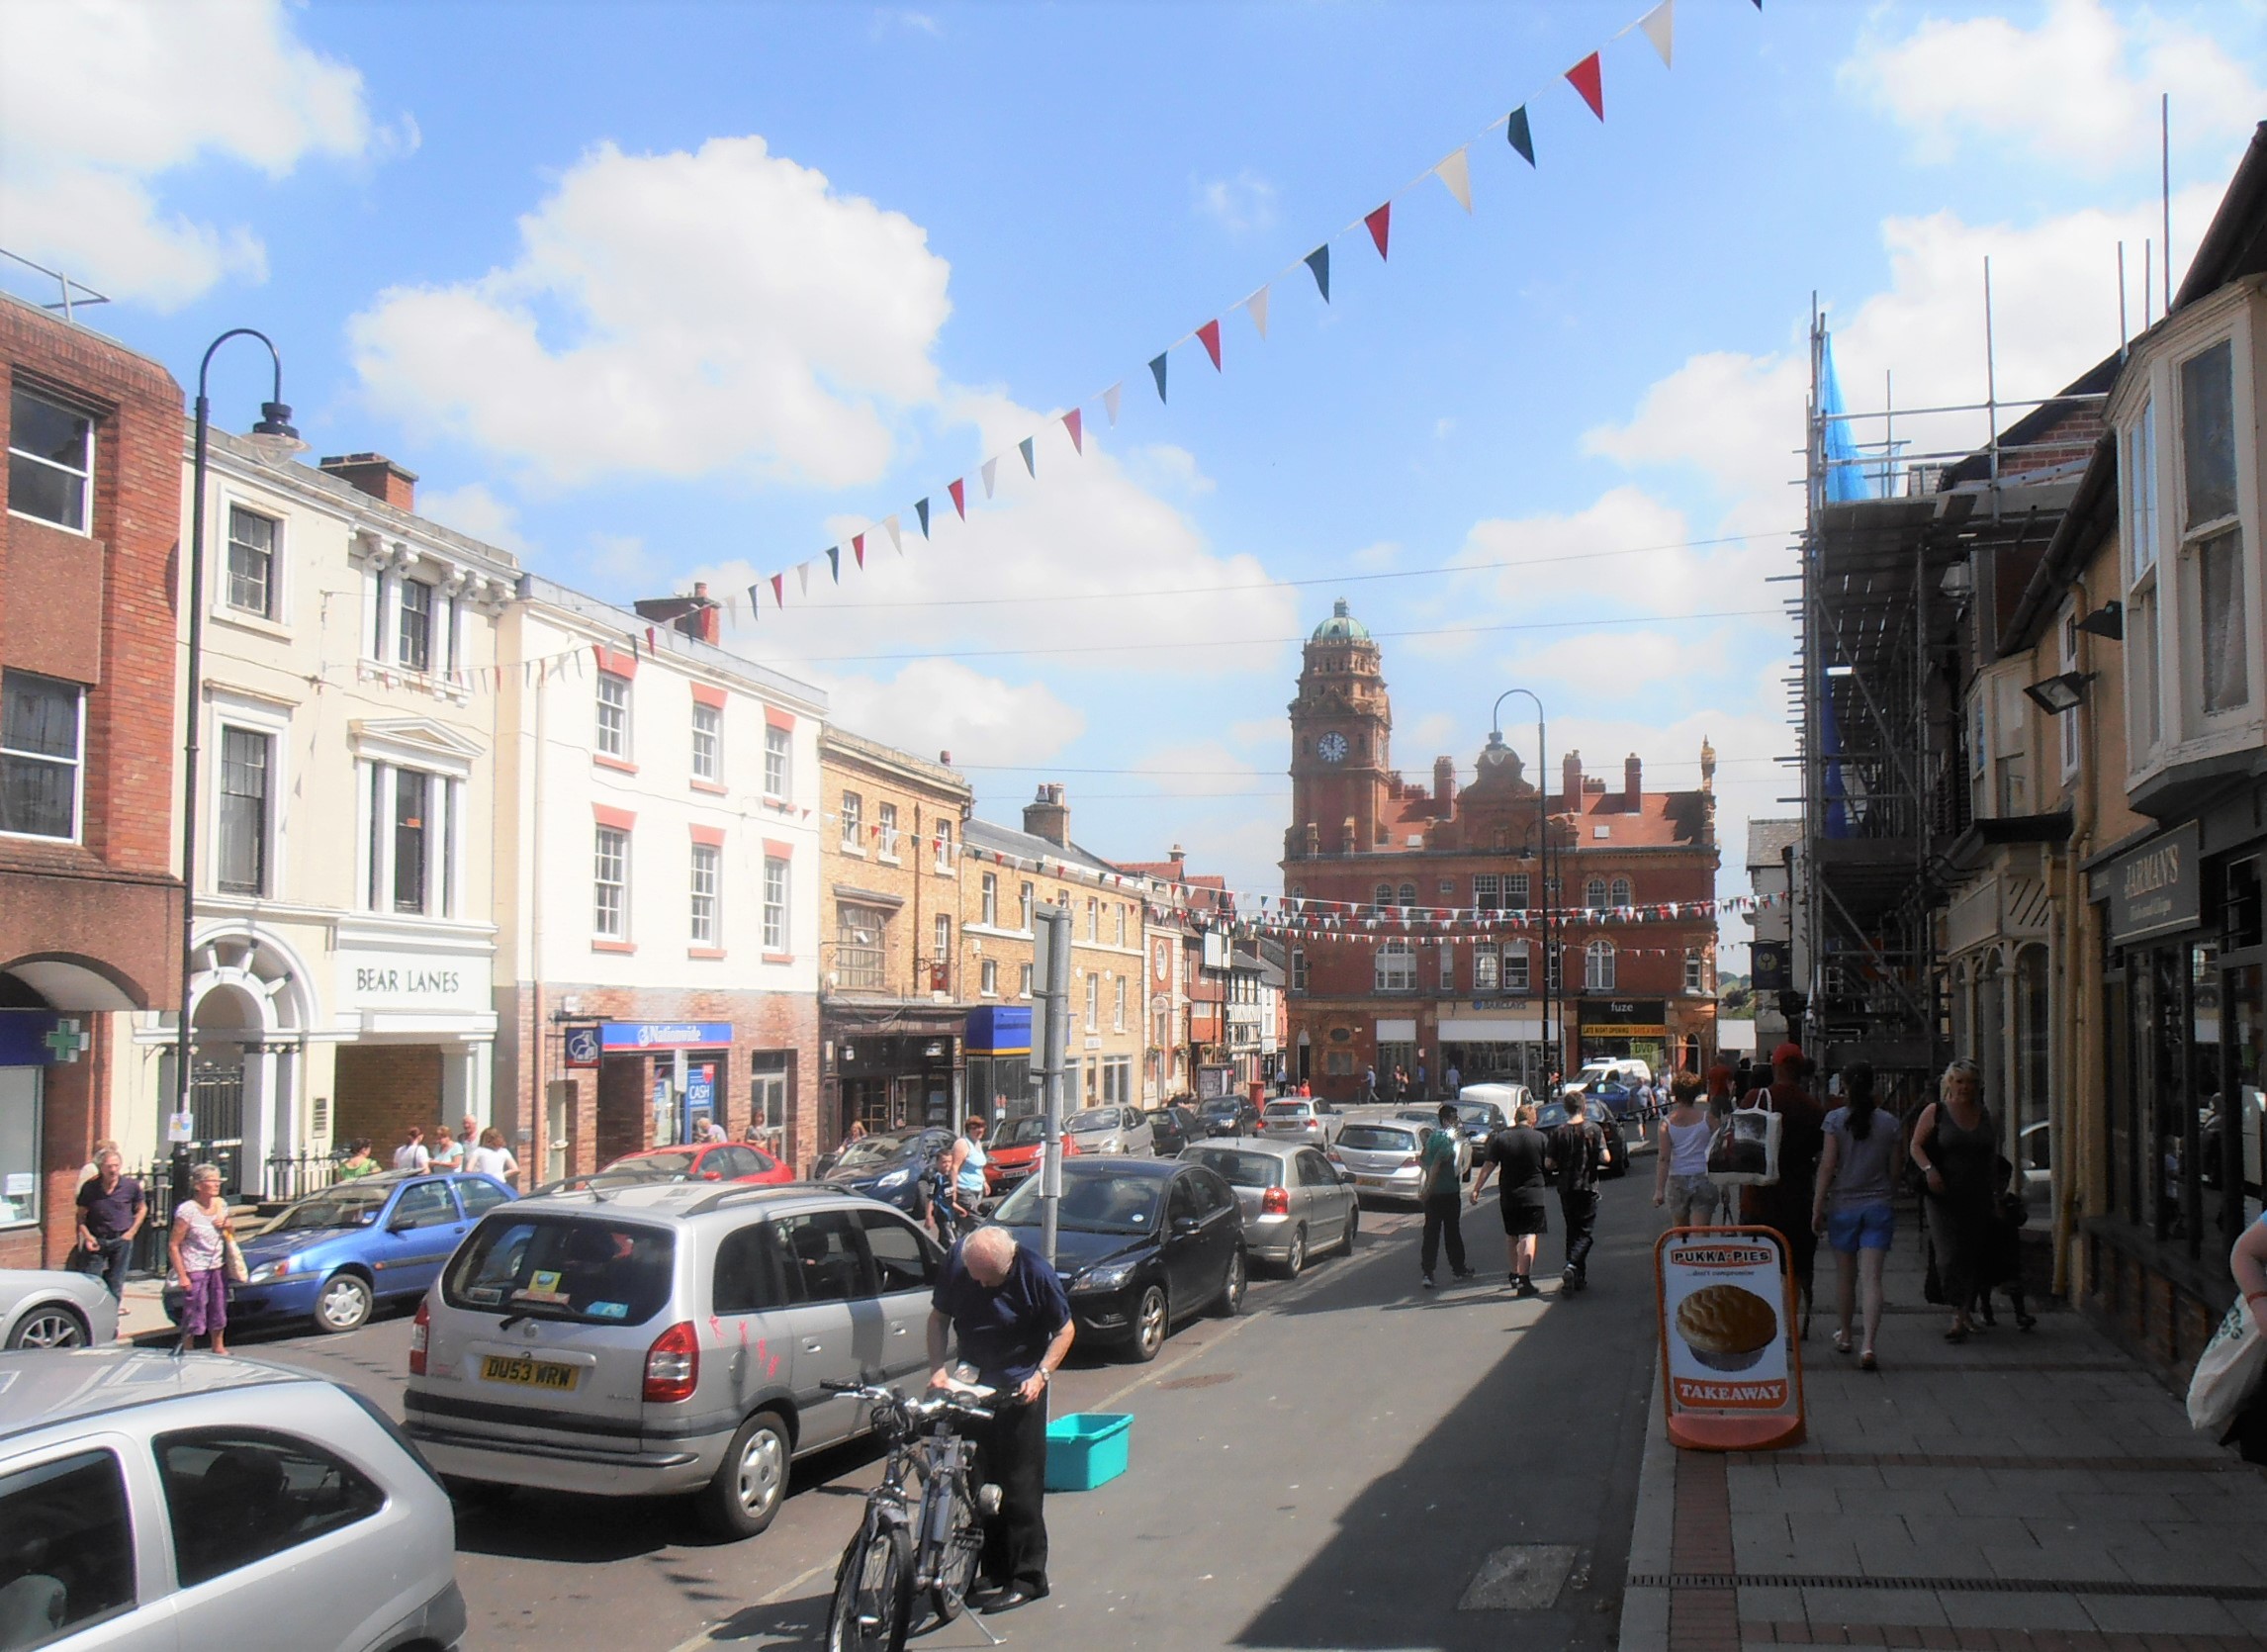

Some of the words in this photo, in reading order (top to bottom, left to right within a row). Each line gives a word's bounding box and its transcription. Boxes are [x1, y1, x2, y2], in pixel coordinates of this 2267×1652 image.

[356, 967, 399, 992] BEAR
[407, 969, 459, 993] LANES
[1610, 1001, 1634, 1012] fuze
[650, 1025, 701, 1043] Nationwide
[1609, 1026, 1630, 1035] OPENING
[1634, 1044, 1654, 1054] DVD
[689, 1084, 710, 1100] CASH
[486, 1359, 533, 1381] DU53
[1679, 1384, 1781, 1401] TAKEAWAY
